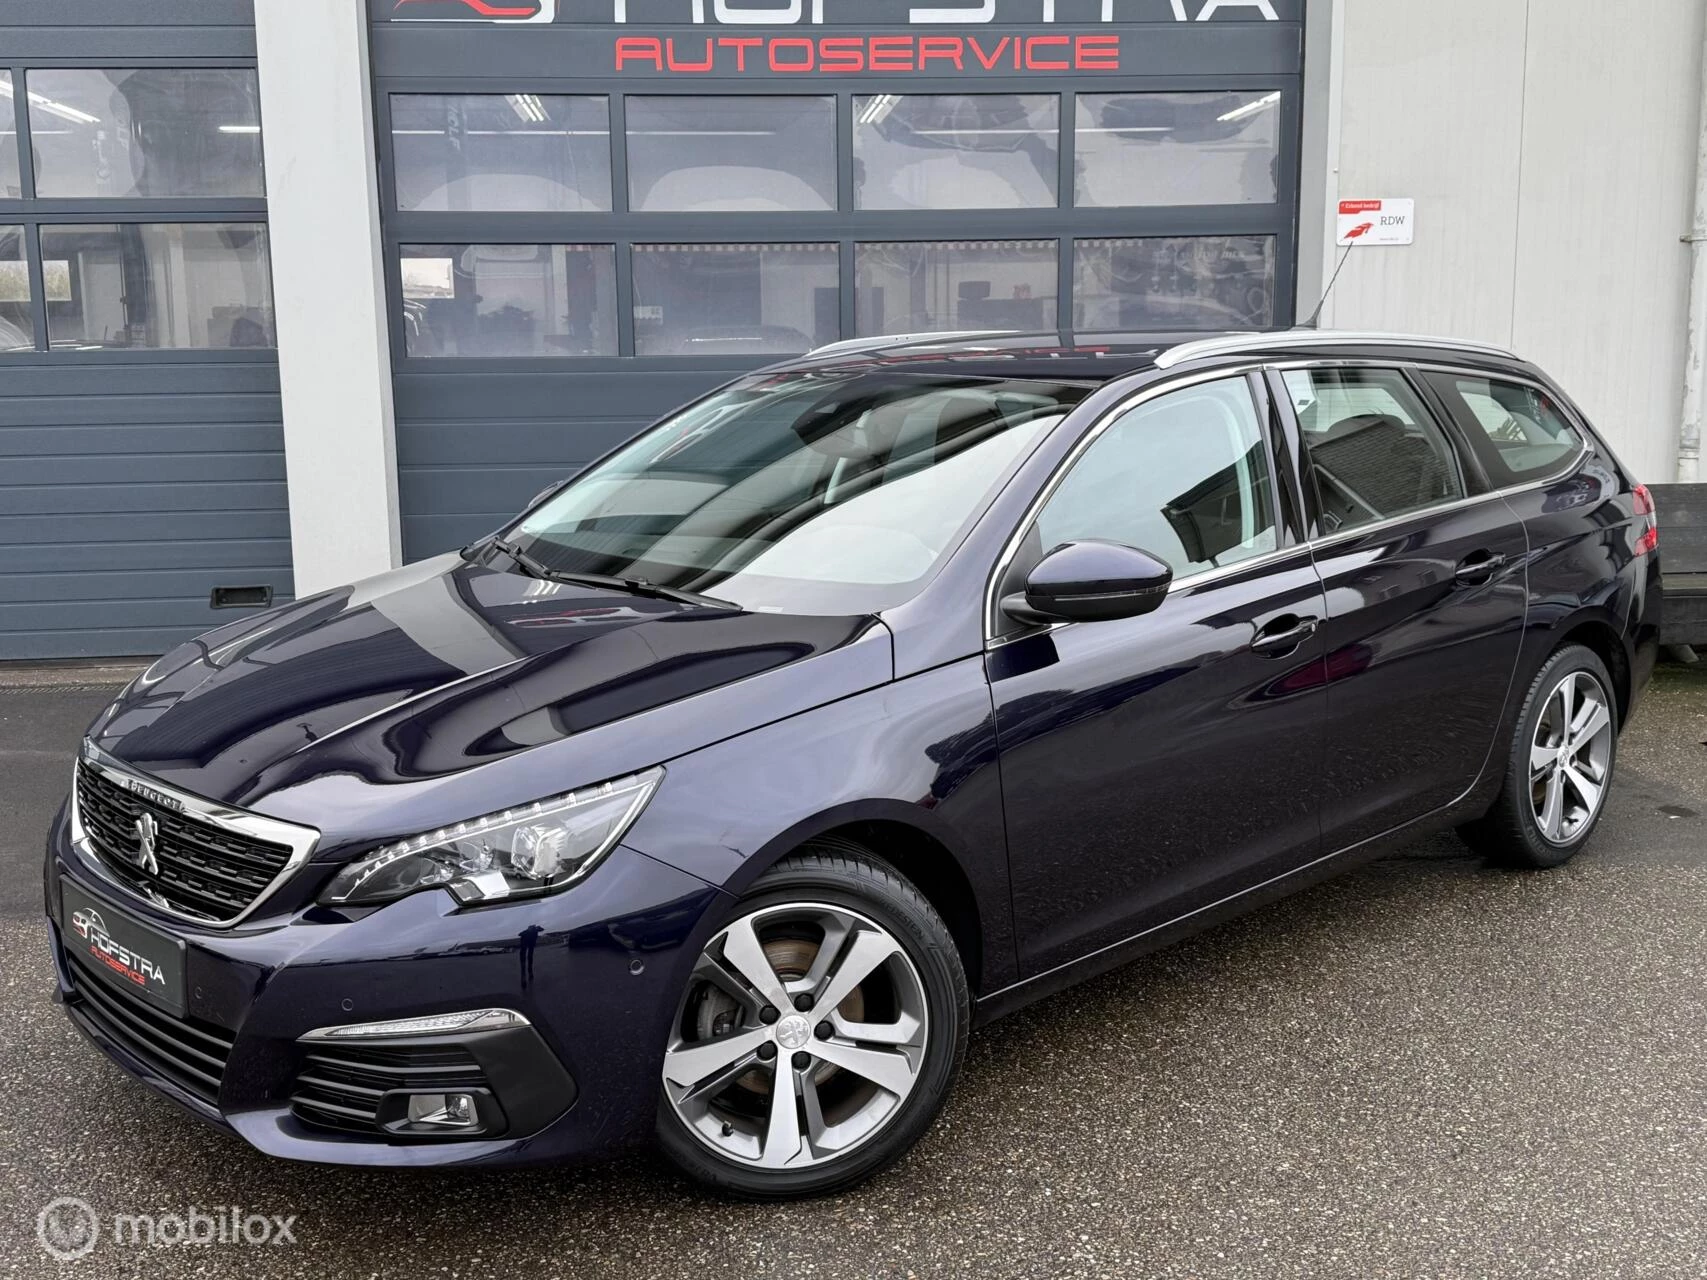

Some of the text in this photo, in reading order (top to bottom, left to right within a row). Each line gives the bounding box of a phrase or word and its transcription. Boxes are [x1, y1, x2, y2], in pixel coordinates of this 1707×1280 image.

[615, 36, 1120, 71] AUTOSERVICE
[1380, 215, 1405, 226] RDW
[91, 927, 165, 985] HOFSTRA
[91, 944, 146, 986] AUTOSERVICE
